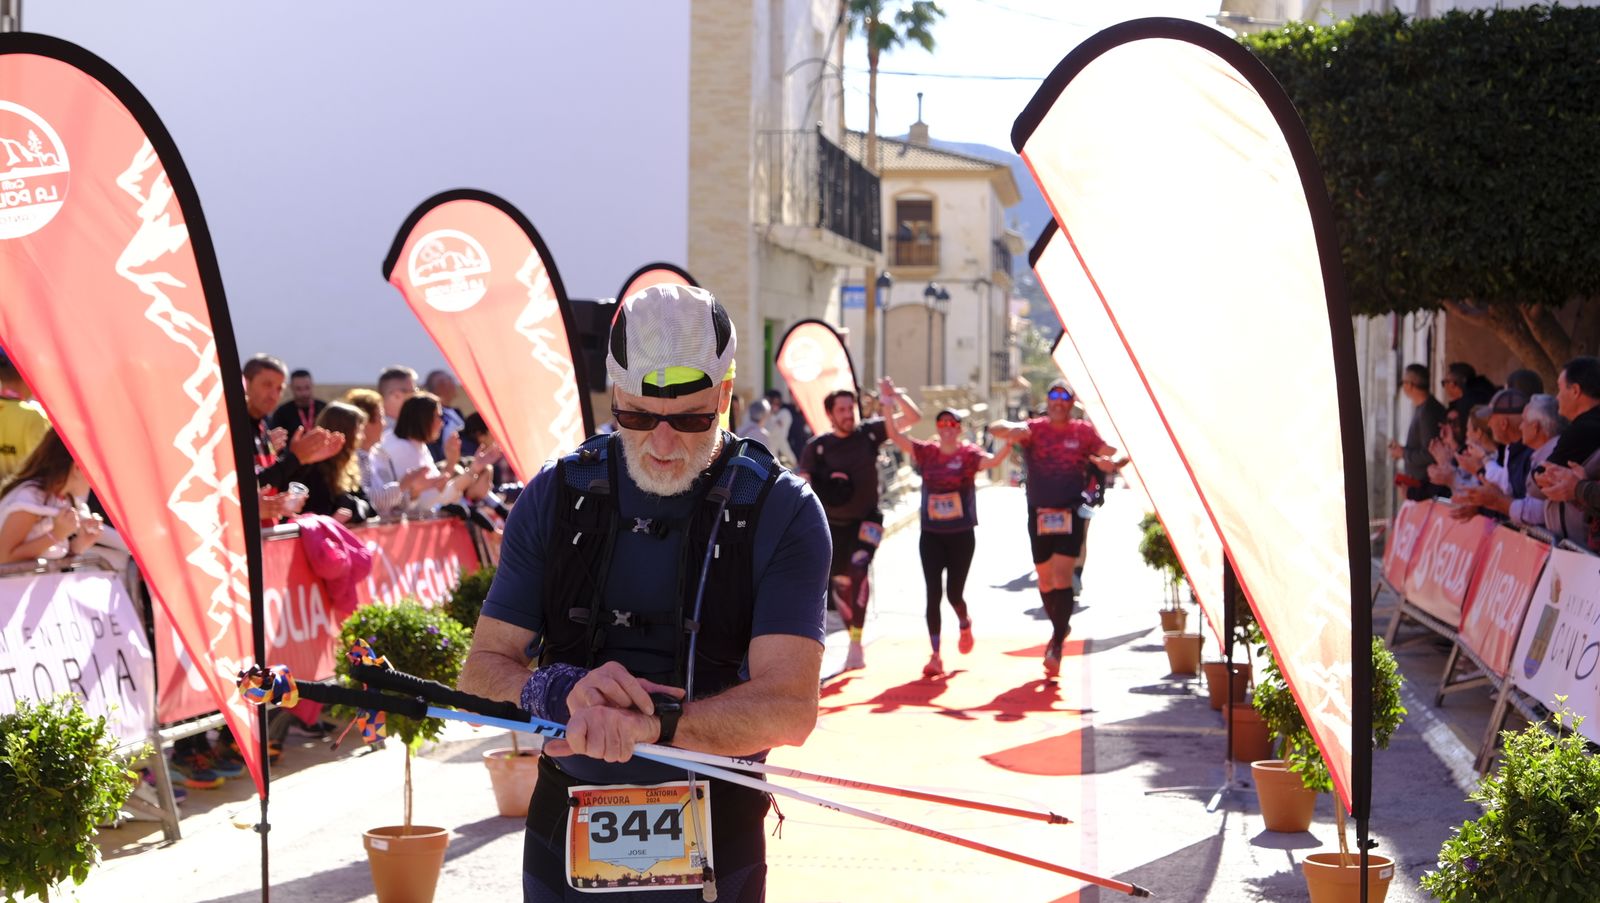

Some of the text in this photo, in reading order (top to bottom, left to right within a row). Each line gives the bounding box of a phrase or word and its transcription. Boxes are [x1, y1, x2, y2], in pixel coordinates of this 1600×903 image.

[90, 614, 122, 640] DE
[645, 789, 678, 797] CANTORIA
[590, 808, 683, 844] 344
[627, 848, 648, 856] JOSE
